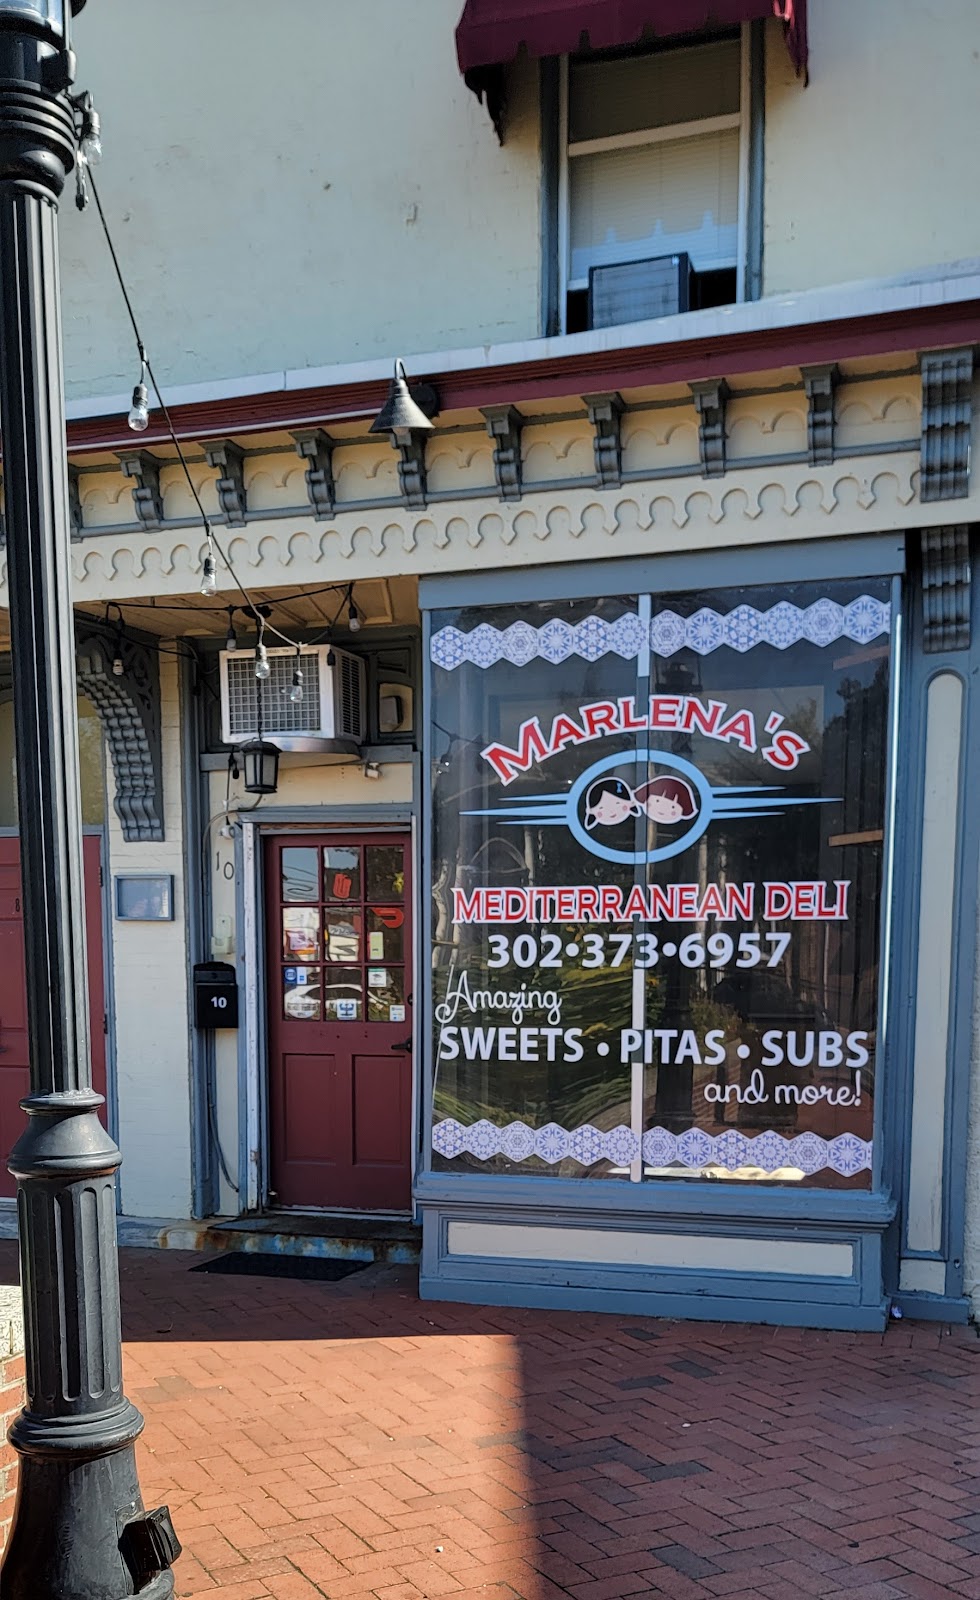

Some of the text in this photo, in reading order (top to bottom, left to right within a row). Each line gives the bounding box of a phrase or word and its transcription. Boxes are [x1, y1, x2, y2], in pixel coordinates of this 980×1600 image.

[481, 695, 810, 786] MARLENA'S
[451, 880, 851, 924] MEDITERRANEAN DELI
[211, 997, 227, 1008] 10
[435, 970, 562, 1025] Amazing
[440, 1026, 870, 1068] SWEETS PITAS SUBS
[703, 1067, 863, 1107] and more!
